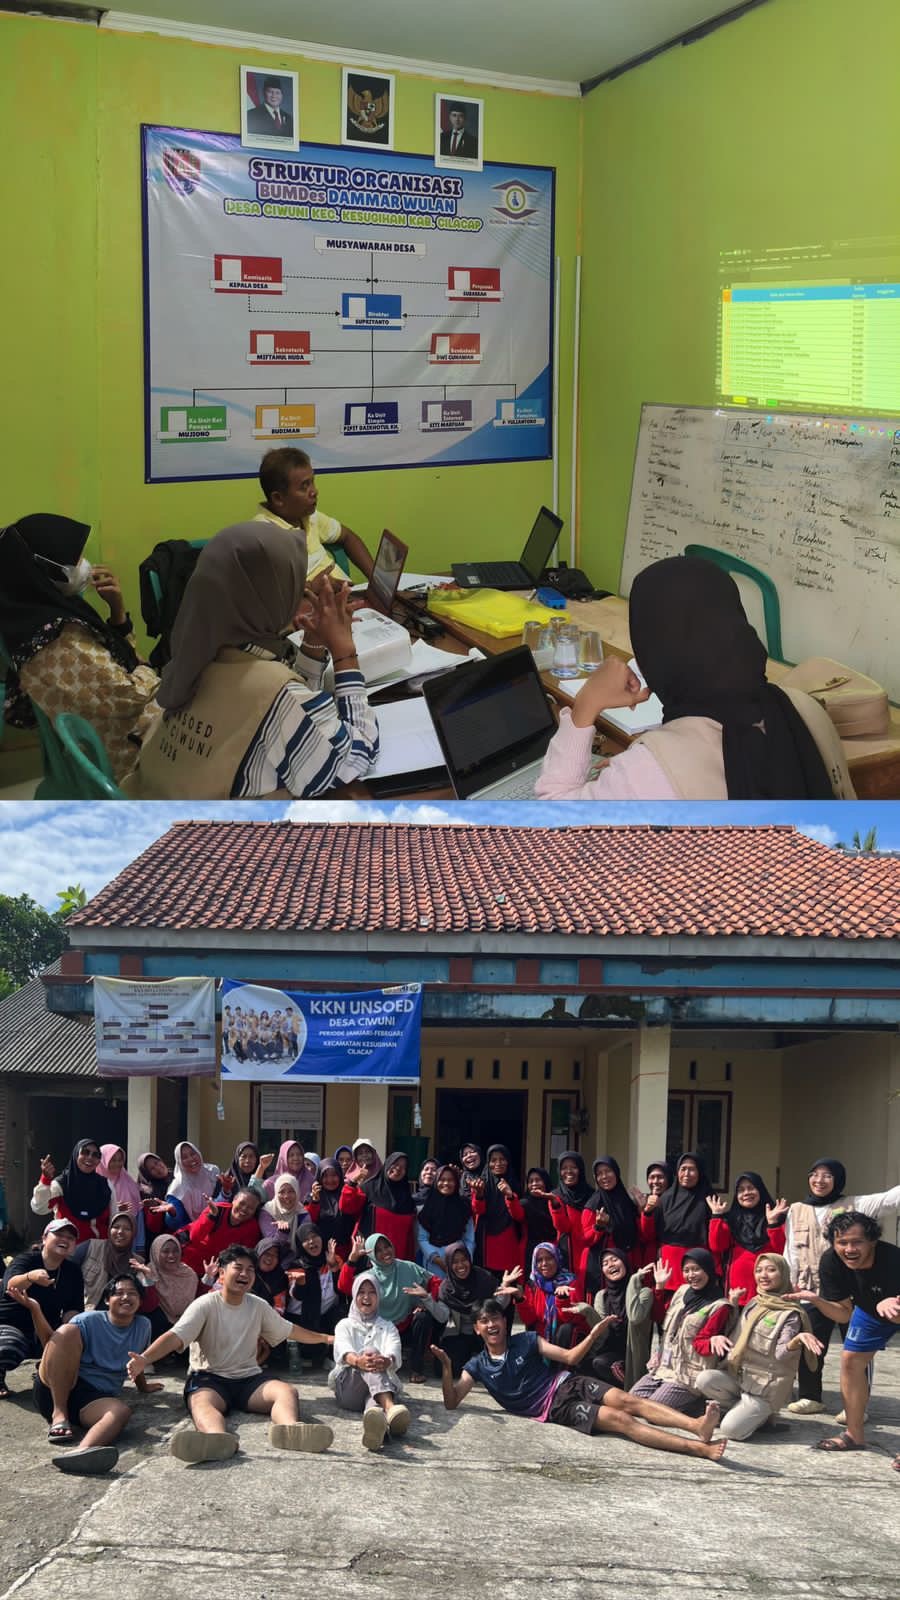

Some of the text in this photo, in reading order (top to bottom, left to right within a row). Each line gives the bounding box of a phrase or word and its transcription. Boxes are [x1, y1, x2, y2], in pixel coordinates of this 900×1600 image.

[251, 160, 462, 196] STRUKTUR ORGANISASI
[259, 182, 455, 213] BUMDes DAMMAR WULAN
[224, 199, 261, 216] DESA
[263, 202, 309, 219] CIWUNI
[311, 206, 339, 221] KEC.
[341, 209, 406, 226] KESUGIHAN
[408, 215, 435, 228] KAB.
[437, 217, 483, 231] CILACAP
[326, 239, 416, 253] MUSYAWARAH DESA
[173, 710, 213, 738] NSOED
[170, 725, 213, 758] CIWUNI
[310, 999, 414, 1014] KKN UNSOED
[329, 1016, 395, 1027] DESA CIWUNI
